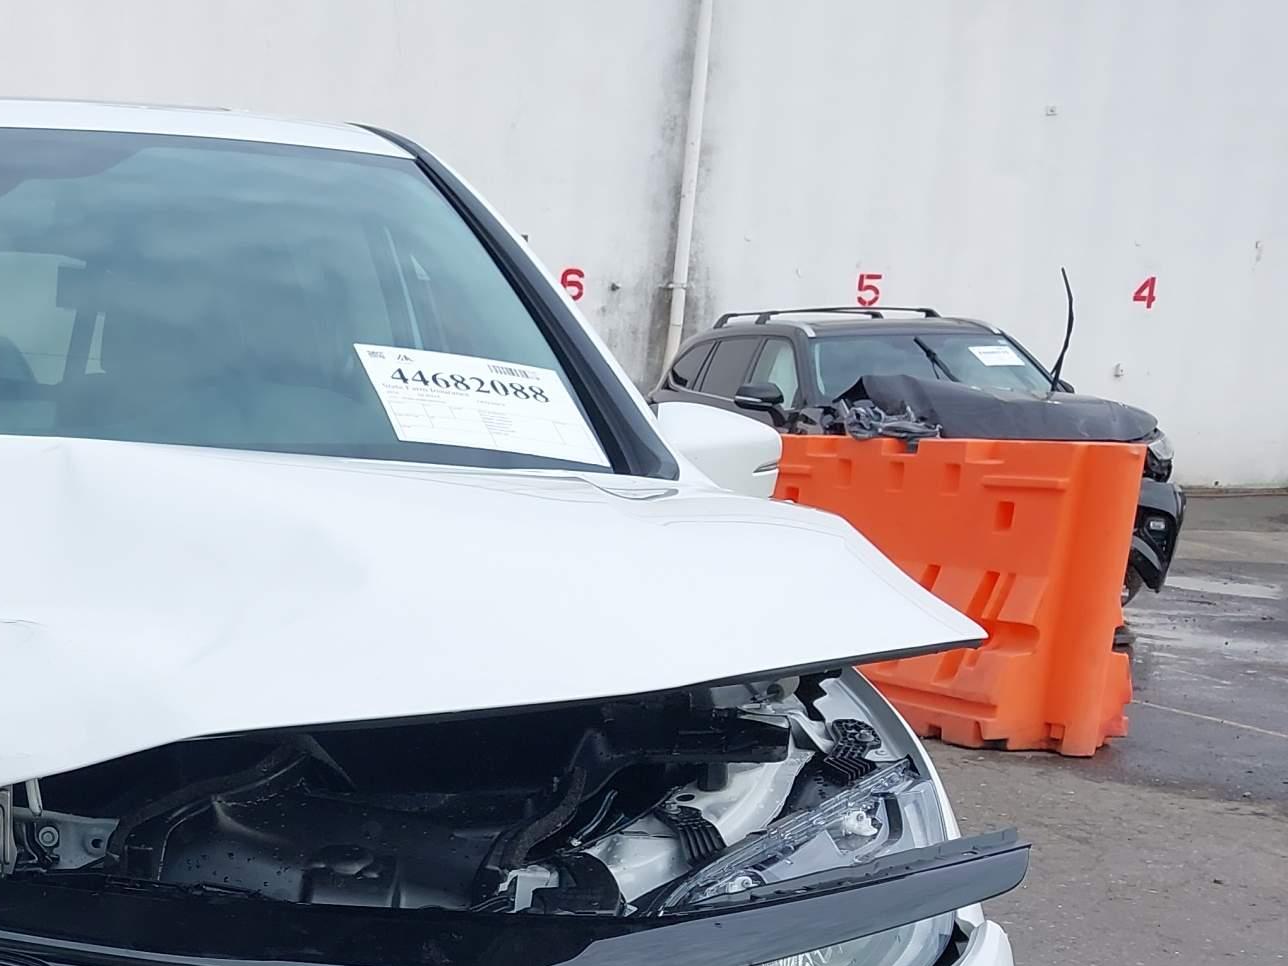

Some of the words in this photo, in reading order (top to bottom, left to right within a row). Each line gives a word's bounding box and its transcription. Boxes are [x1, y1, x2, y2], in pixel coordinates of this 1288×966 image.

[560, 268, 585, 302] 6
[857, 273, 882, 306] 5
[1133, 276, 1157, 309] 4
[391, 367, 550, 403] 44682088
